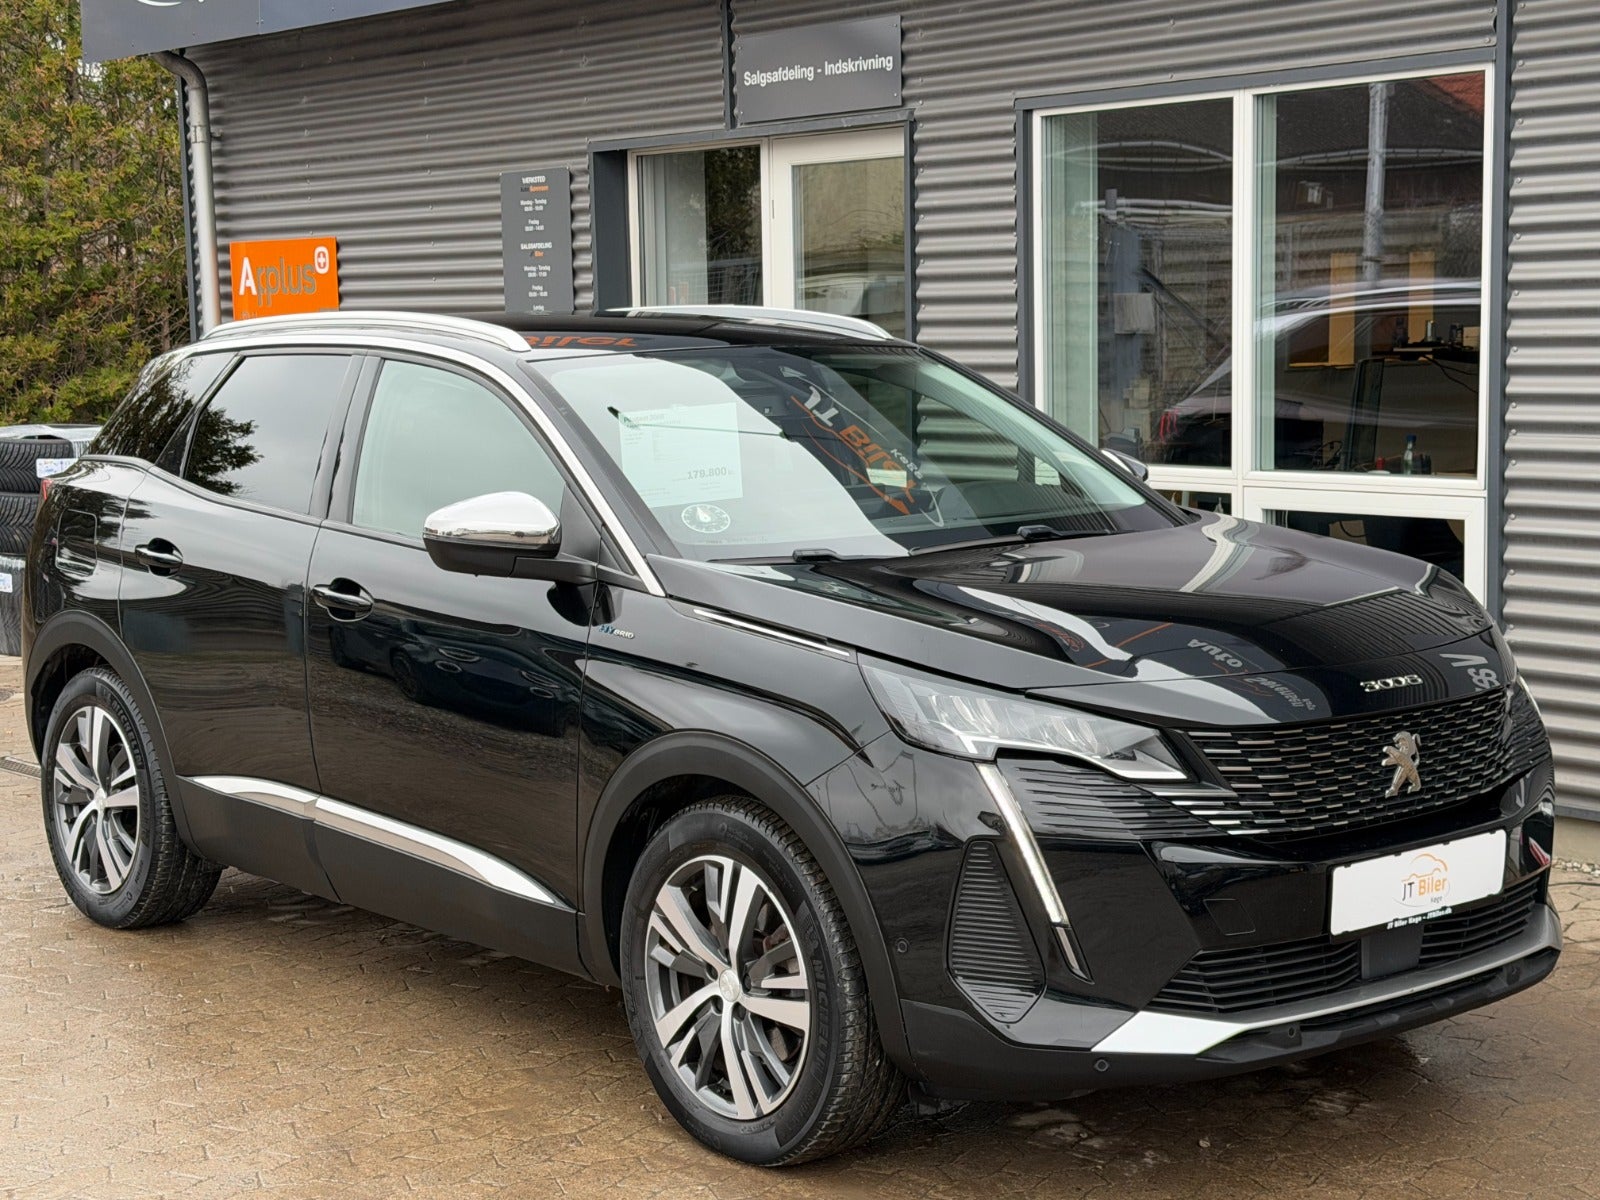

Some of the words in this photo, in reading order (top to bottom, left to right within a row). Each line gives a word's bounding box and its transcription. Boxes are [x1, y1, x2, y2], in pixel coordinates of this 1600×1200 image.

[743, 64, 815, 87] Salgsafdeling
[824, 54, 894, 76] Indskrivning
[1359, 674, 1424, 692] 3008
[1402, 881, 1415, 902] JT
[1418, 876, 1447, 896] Biler
